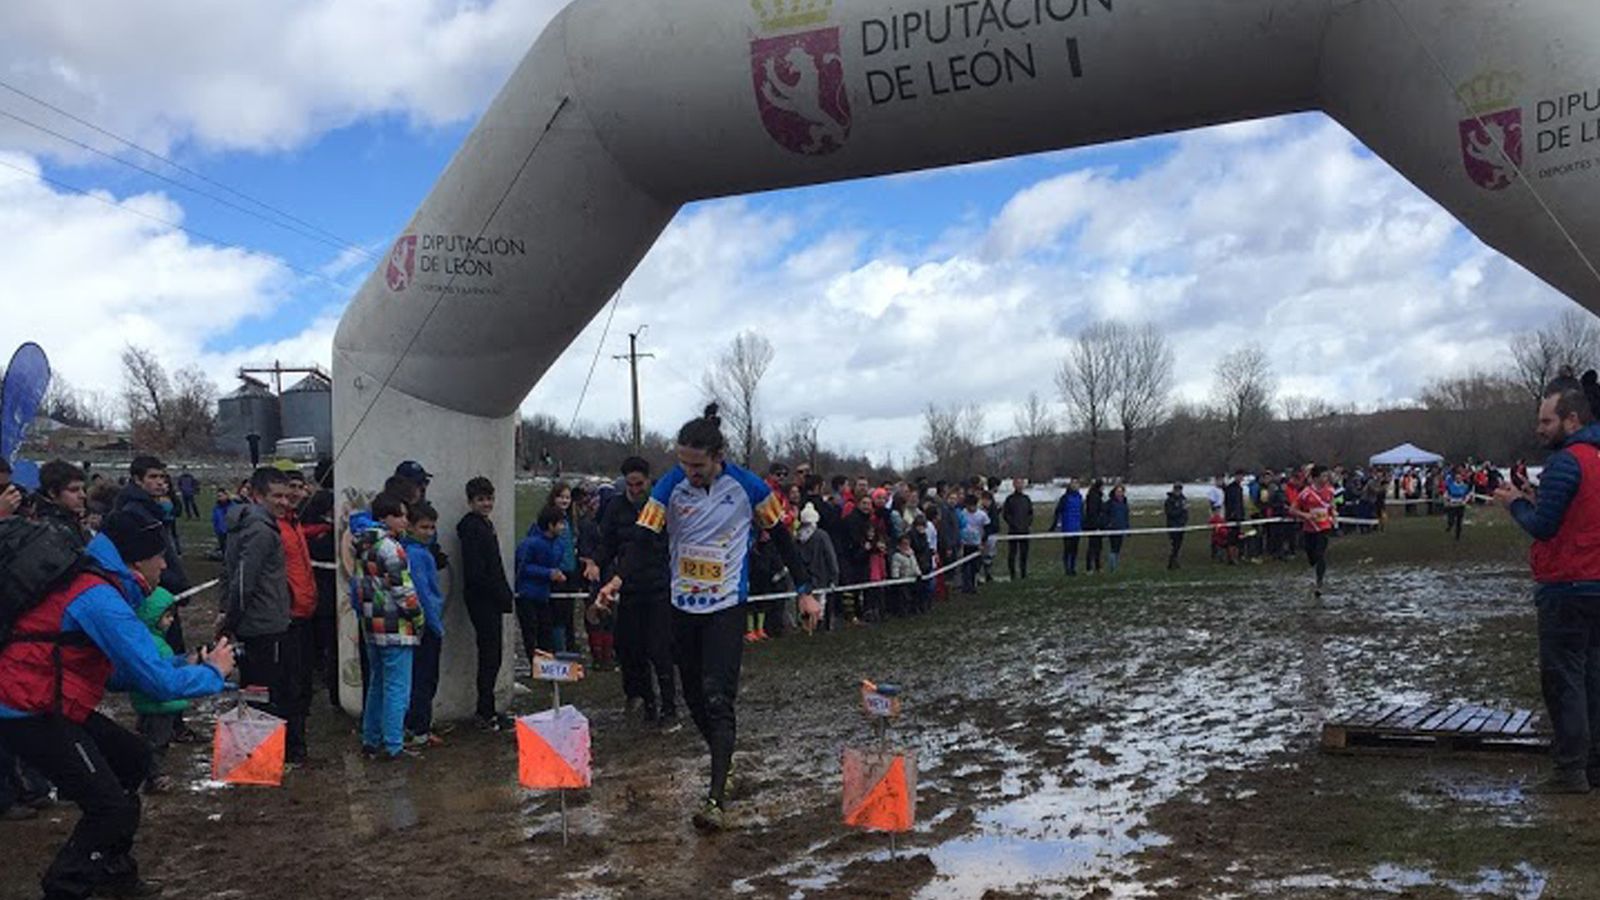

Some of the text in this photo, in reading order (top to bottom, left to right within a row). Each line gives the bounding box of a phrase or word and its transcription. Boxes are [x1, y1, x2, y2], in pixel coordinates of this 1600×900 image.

[866, 39, 1036, 105] DE LEÓN
[1537, 118, 1600, 153] DE L
[420, 254, 440, 273] DE
[541, 663, 568, 676] META
